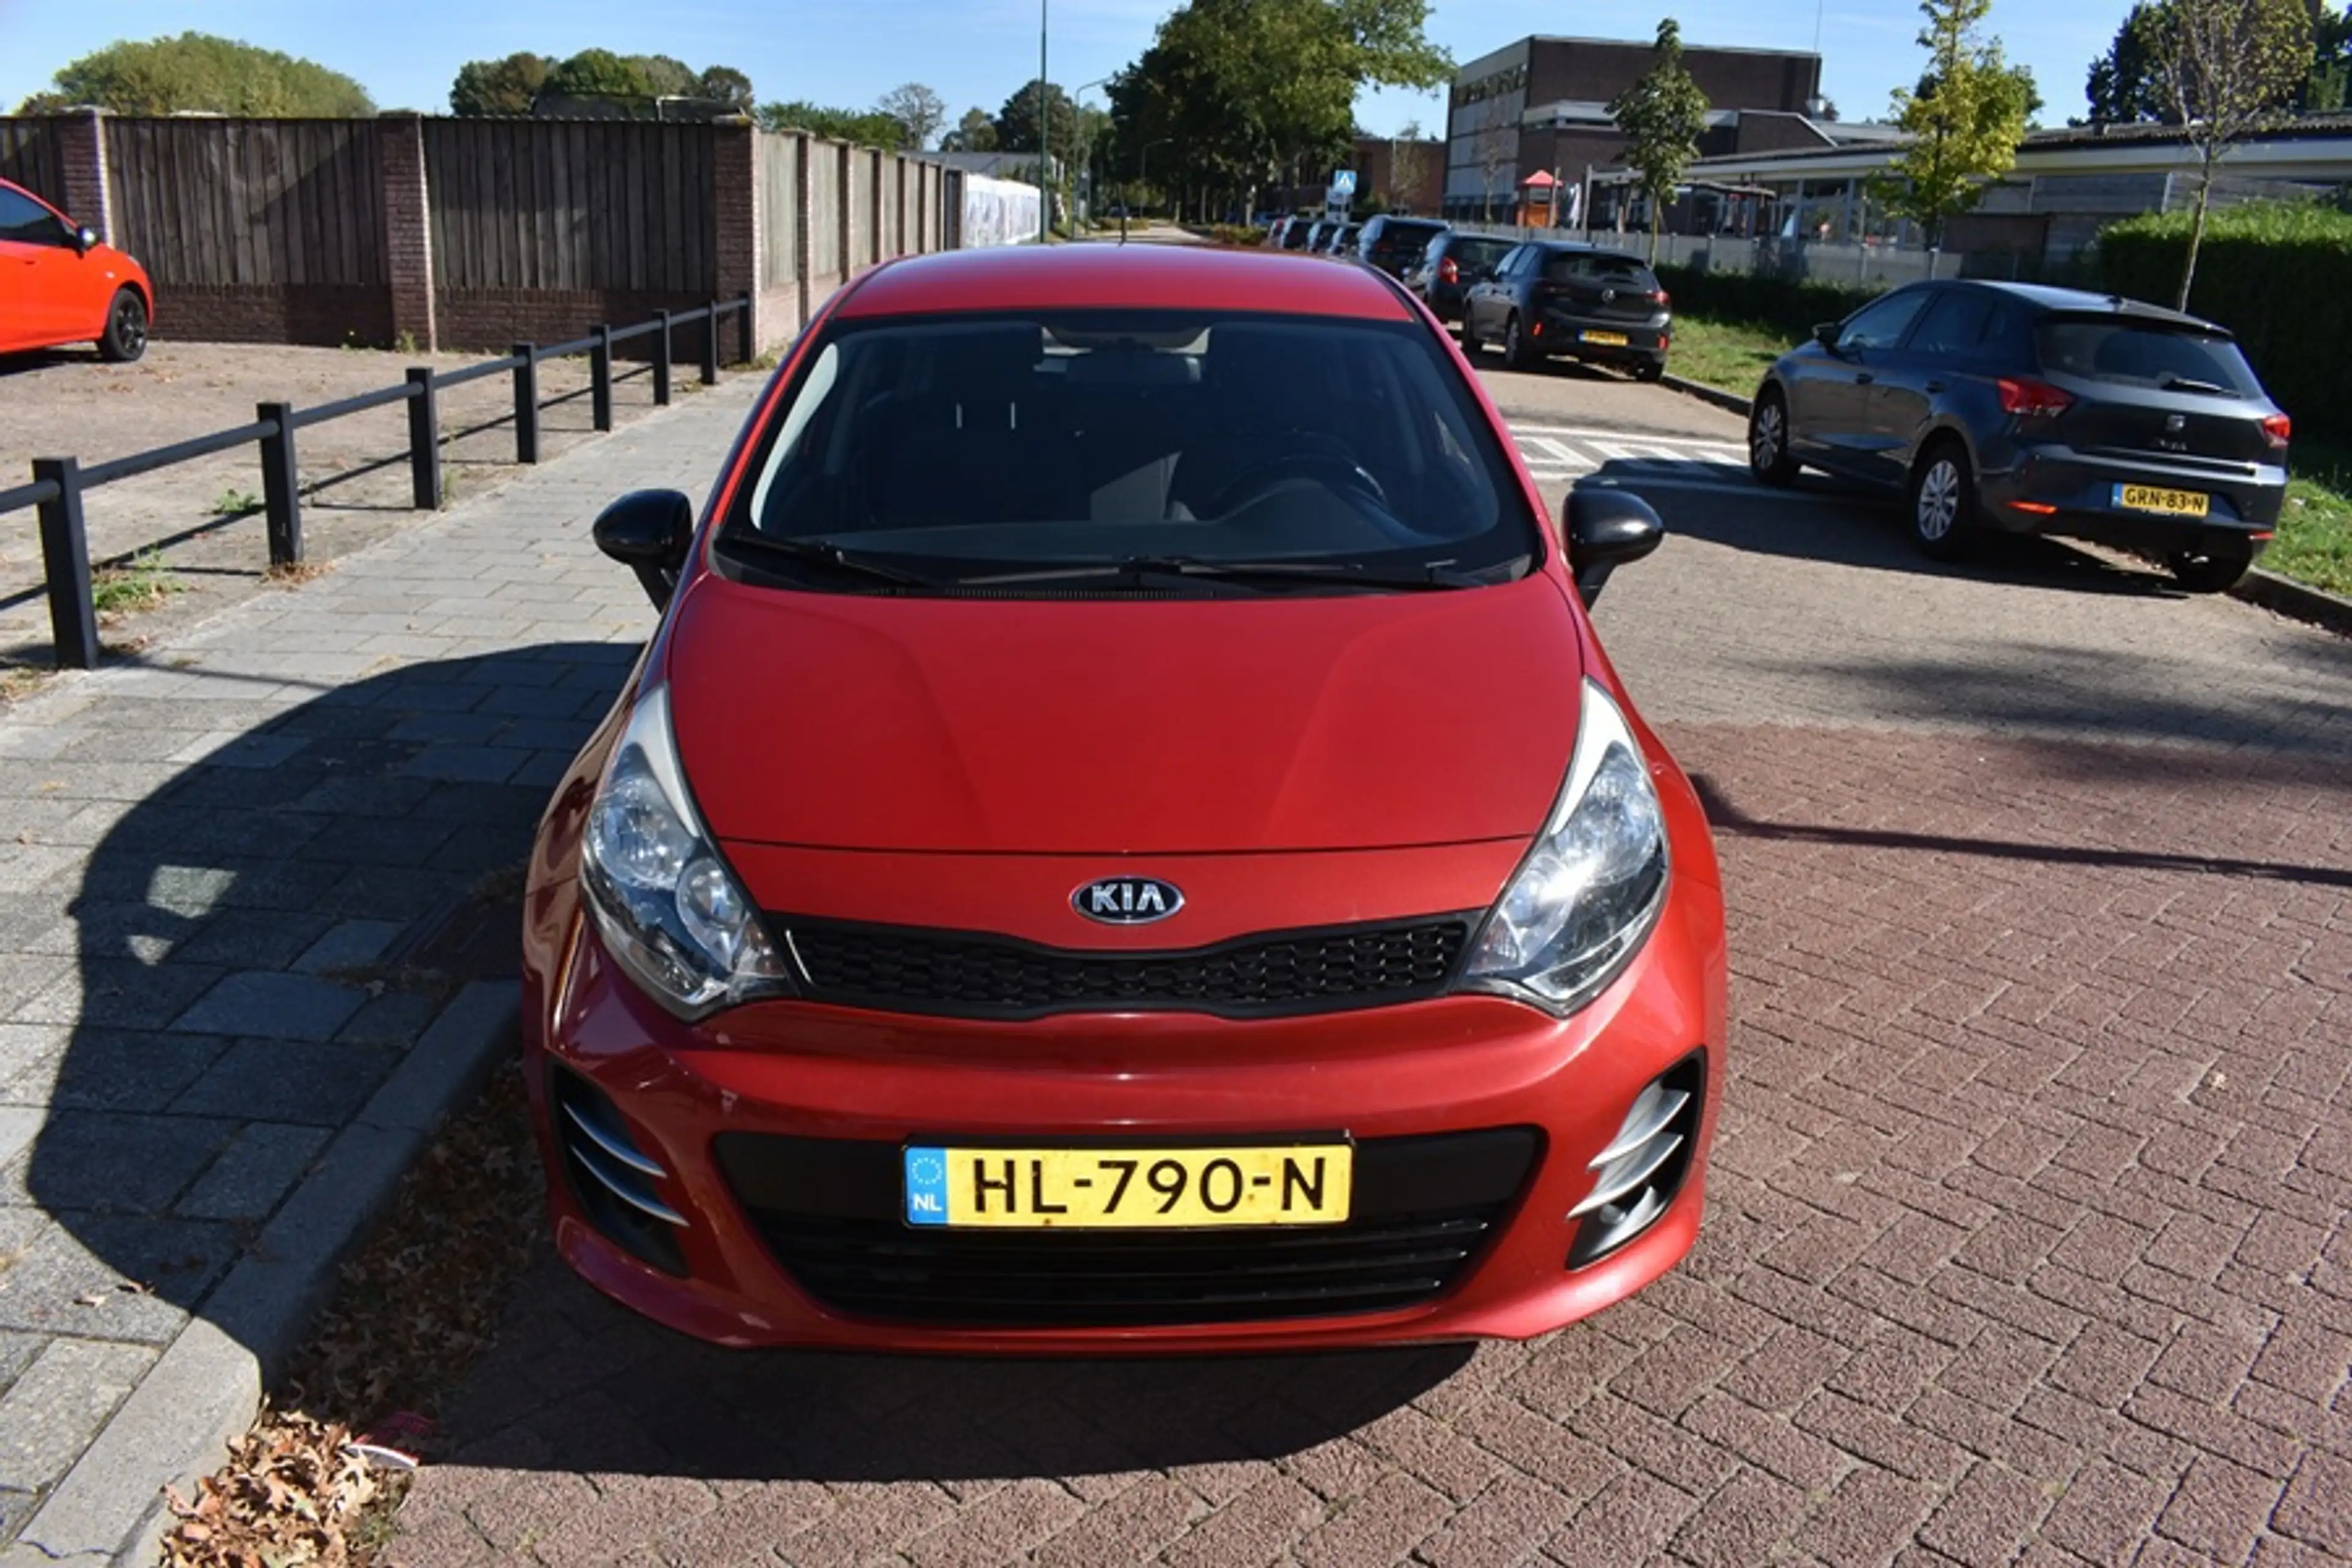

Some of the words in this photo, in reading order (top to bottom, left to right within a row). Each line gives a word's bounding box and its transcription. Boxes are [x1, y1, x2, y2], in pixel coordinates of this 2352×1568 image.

[2125, 488, 2204, 511] GRN-83-N
[1091, 883, 1165, 912] KIA
[974, 1158, 1325, 1213] HL-790-N
[913, 1194, 942, 1211] NL
